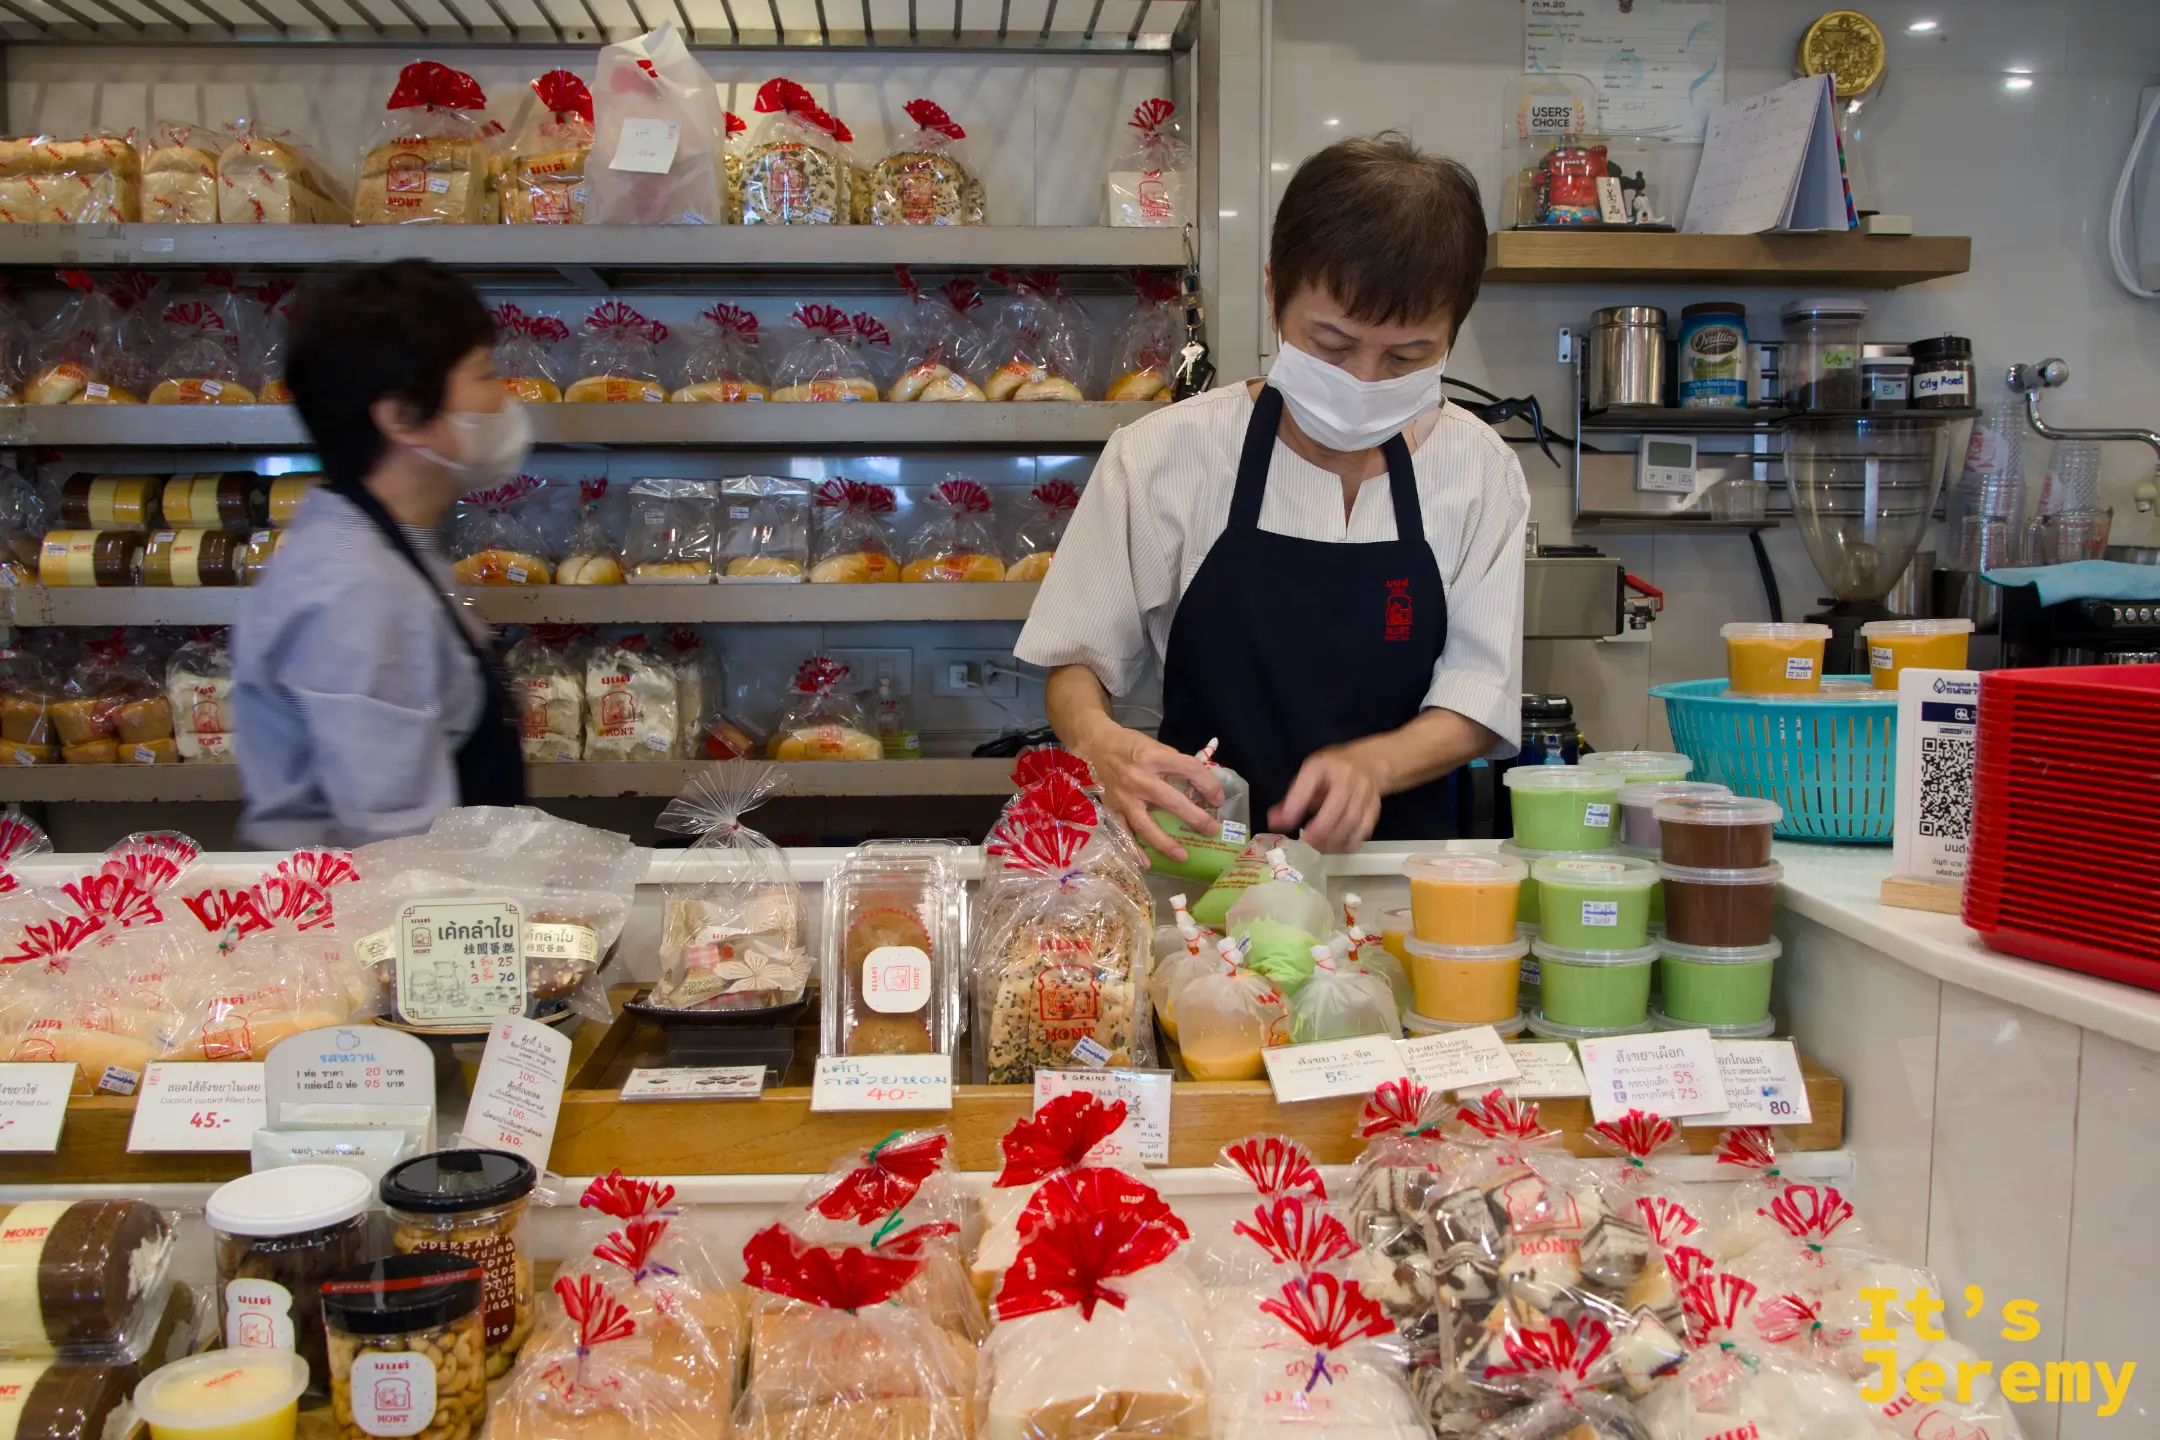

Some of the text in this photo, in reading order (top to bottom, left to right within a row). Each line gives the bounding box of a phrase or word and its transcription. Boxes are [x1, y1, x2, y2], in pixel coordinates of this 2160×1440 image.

[1532, 118, 1570, 128] CHOICE
[1693, 331, 1737, 350] Ovaltine
[1702, 379, 1737, 387] chocolate
[1919, 374, 1964, 391] City Roast
[606, 727, 635, 737] MONT
[438, 916, 514, 941] เค้กลำไย
[525, 928, 575, 944] ค้กลำไย
[470, 960, 476, 969] 1
[497, 956, 513, 968] 25
[470, 973, 479, 985] 3
[497, 972, 516, 982] 70
[1045, 1027, 1096, 1041] MONT
[319, 1052, 377, 1064] รสหวาน
[1298, 1054, 1337, 1066] สังขยา
[1341, 1053, 1349, 1061] 2
[1616, 1045, 1685, 1064] สังขยาเผือก
[1717, 1054, 1763, 1066] อกโกแลต
[303, 1068, 317, 1078] ห่อ
[321, 1069, 344, 1077] ราคา
[365, 1067, 381, 1077] 20
[386, 1068, 405, 1076] บาท
[822, 1059, 861, 1074] เค้ก
[336, 1081, 343, 1089] 6
[345, 1079, 358, 1089] ห่อ
[364, 1079, 381, 1088] 95
[386, 1080, 405, 1088] บาท
[824, 1071, 947, 1086] กล้วยหอม
[1072, 1074, 1107, 1082] GRAINS
[1628, 1076, 1669, 1090] กระปุกเล็ก
[1631, 1088, 1676, 1102] กระปุกใหญ่
[1726, 1086, 1756, 1098] ะปุกเล็ก
[160, 1097, 263, 1105] Coconut custard filled bun
[1728, 1099, 1763, 1112] ะปุกใหญ่
[189, 1111, 231, 1129] 45.-
[3, 1227, 48, 1239] MONT
[1520, 1239, 1582, 1257] MONT
[0, 1385, 21, 1395] NT
[377, 1414, 409, 1423] MONT
